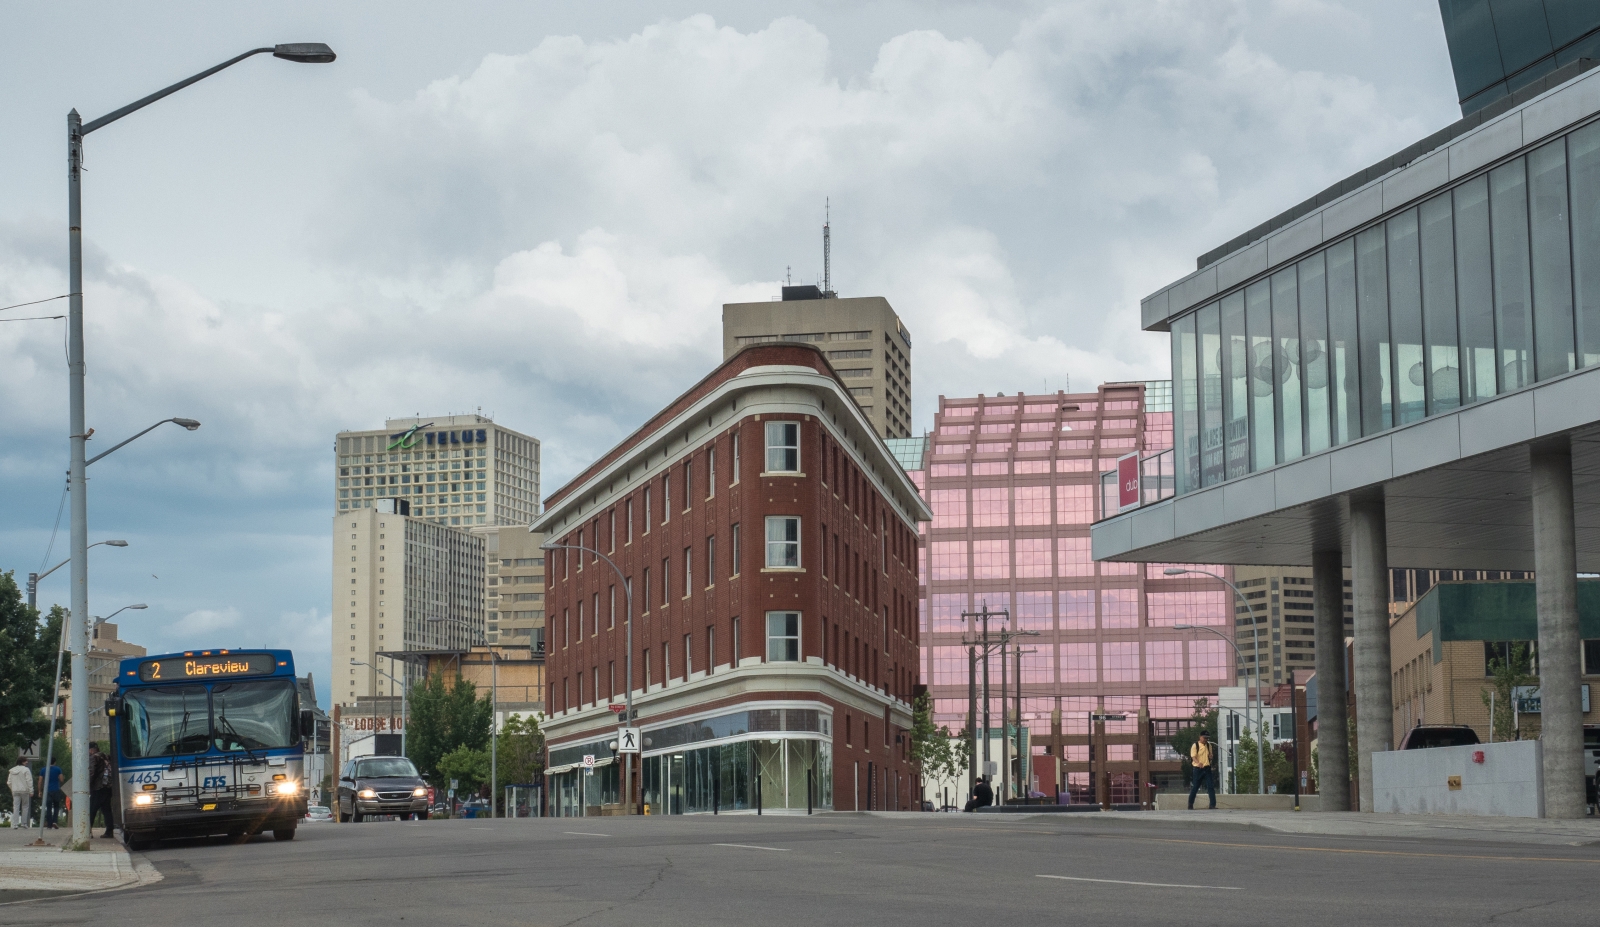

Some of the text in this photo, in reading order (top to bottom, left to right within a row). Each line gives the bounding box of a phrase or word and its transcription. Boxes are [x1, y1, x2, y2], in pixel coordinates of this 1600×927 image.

[425, 429, 487, 445] TELUS
[152, 660, 249, 679] 2 Clareview
[354, 717, 387, 731] LODGE
[127, 771, 161, 785] 4465
[203, 776, 227, 788] ETS
